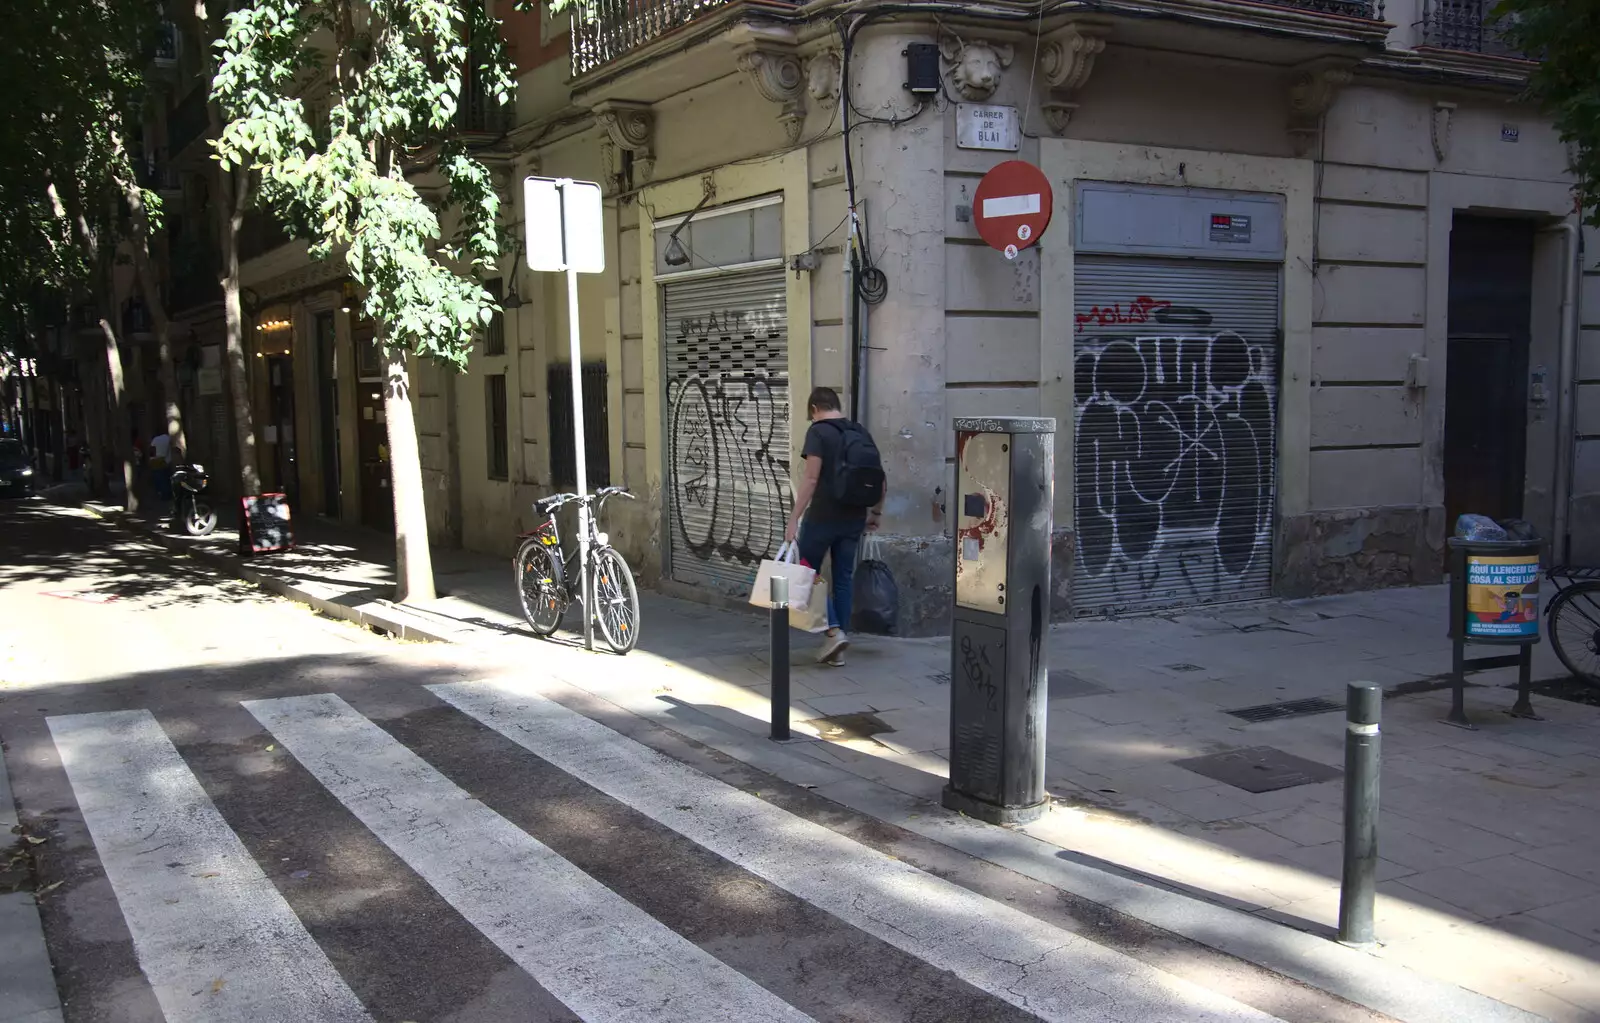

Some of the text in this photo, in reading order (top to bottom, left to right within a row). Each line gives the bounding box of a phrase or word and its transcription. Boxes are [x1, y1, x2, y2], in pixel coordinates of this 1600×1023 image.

[973, 110, 1004, 119] CARRER
[983, 121, 994, 129] DE
[978, 131, 999, 142] BLAI
[1469, 575, 1491, 584] COSA
[1493, 576, 1505, 584] AL
[1506, 575, 1522, 584] SEU
